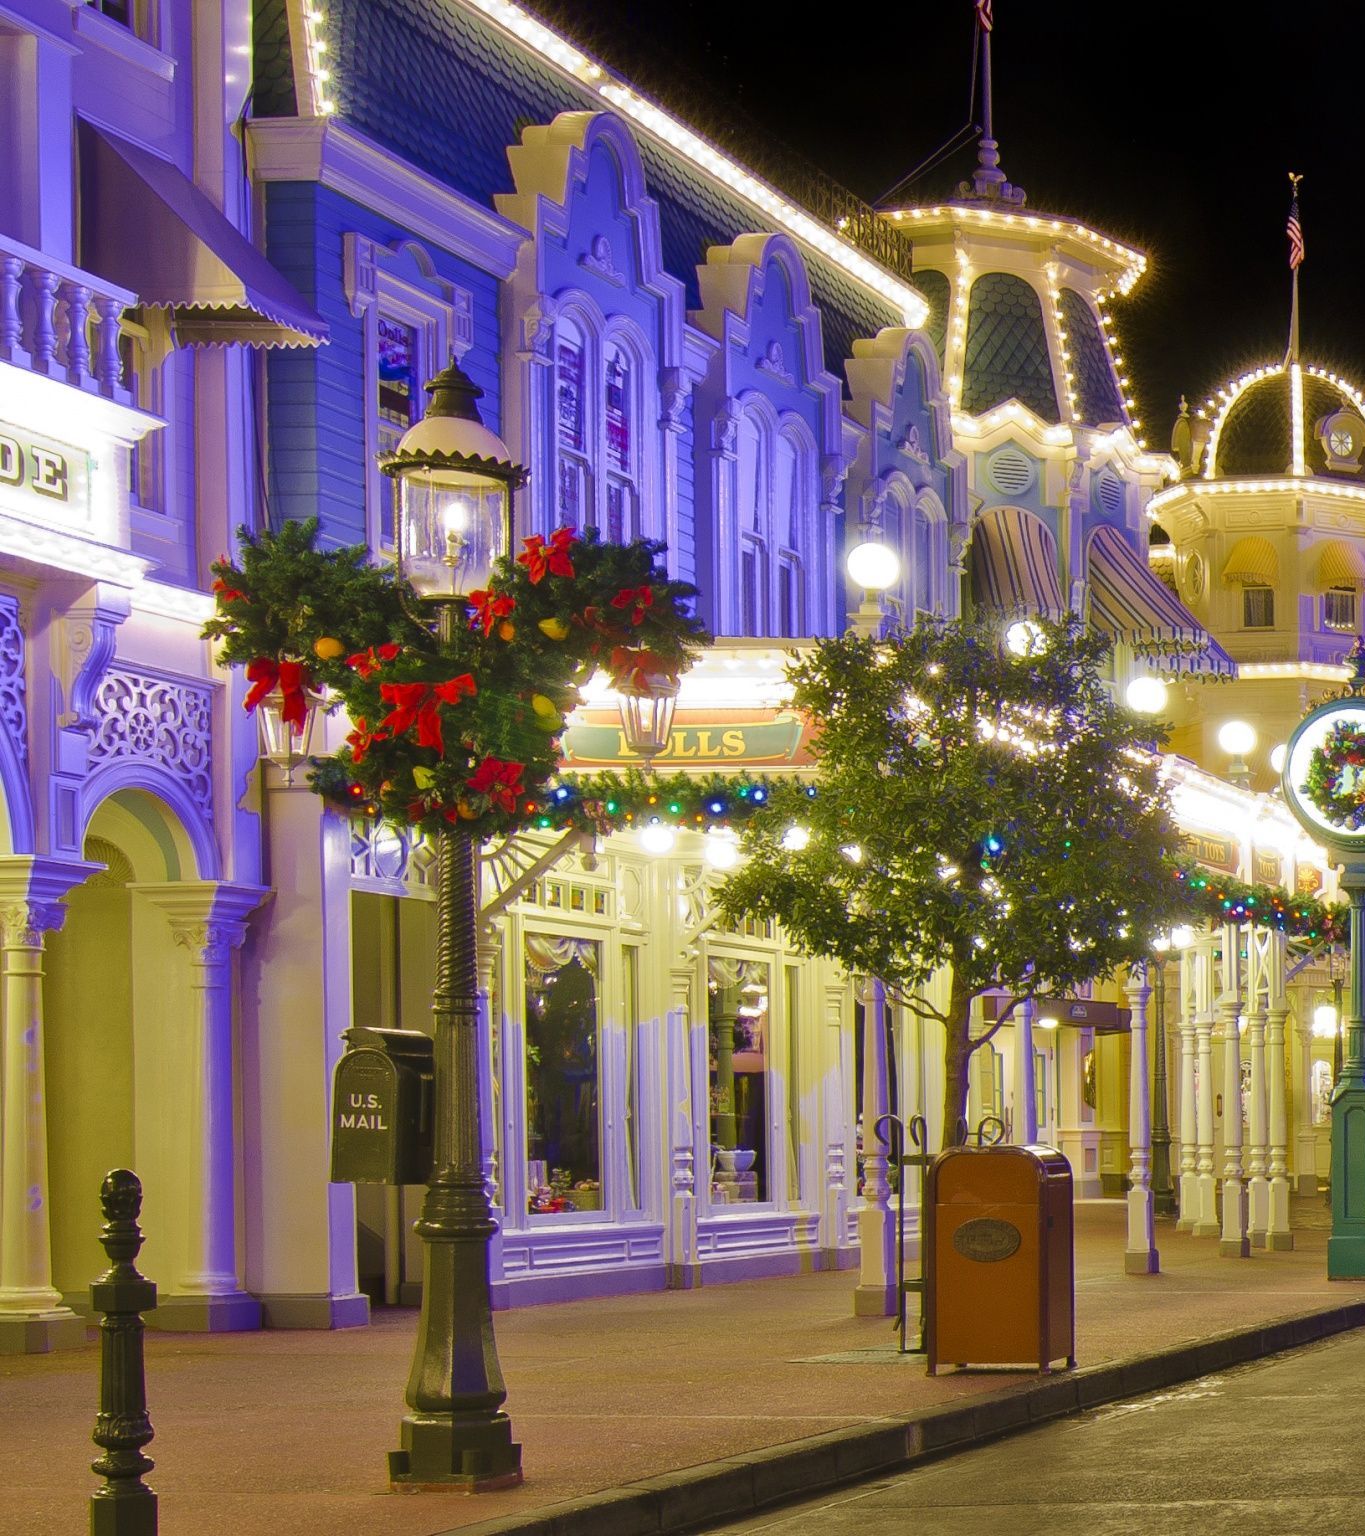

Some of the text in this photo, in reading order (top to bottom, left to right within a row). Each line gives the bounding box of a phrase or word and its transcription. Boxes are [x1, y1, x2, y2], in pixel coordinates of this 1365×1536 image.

[617, 730, 746, 757] LLS
[1203, 841, 1226, 862] TOYS
[1259, 860, 1276, 878] TOYS
[350, 1093, 382, 1109] U.S.
[340, 1114, 388, 1130] MAIL
